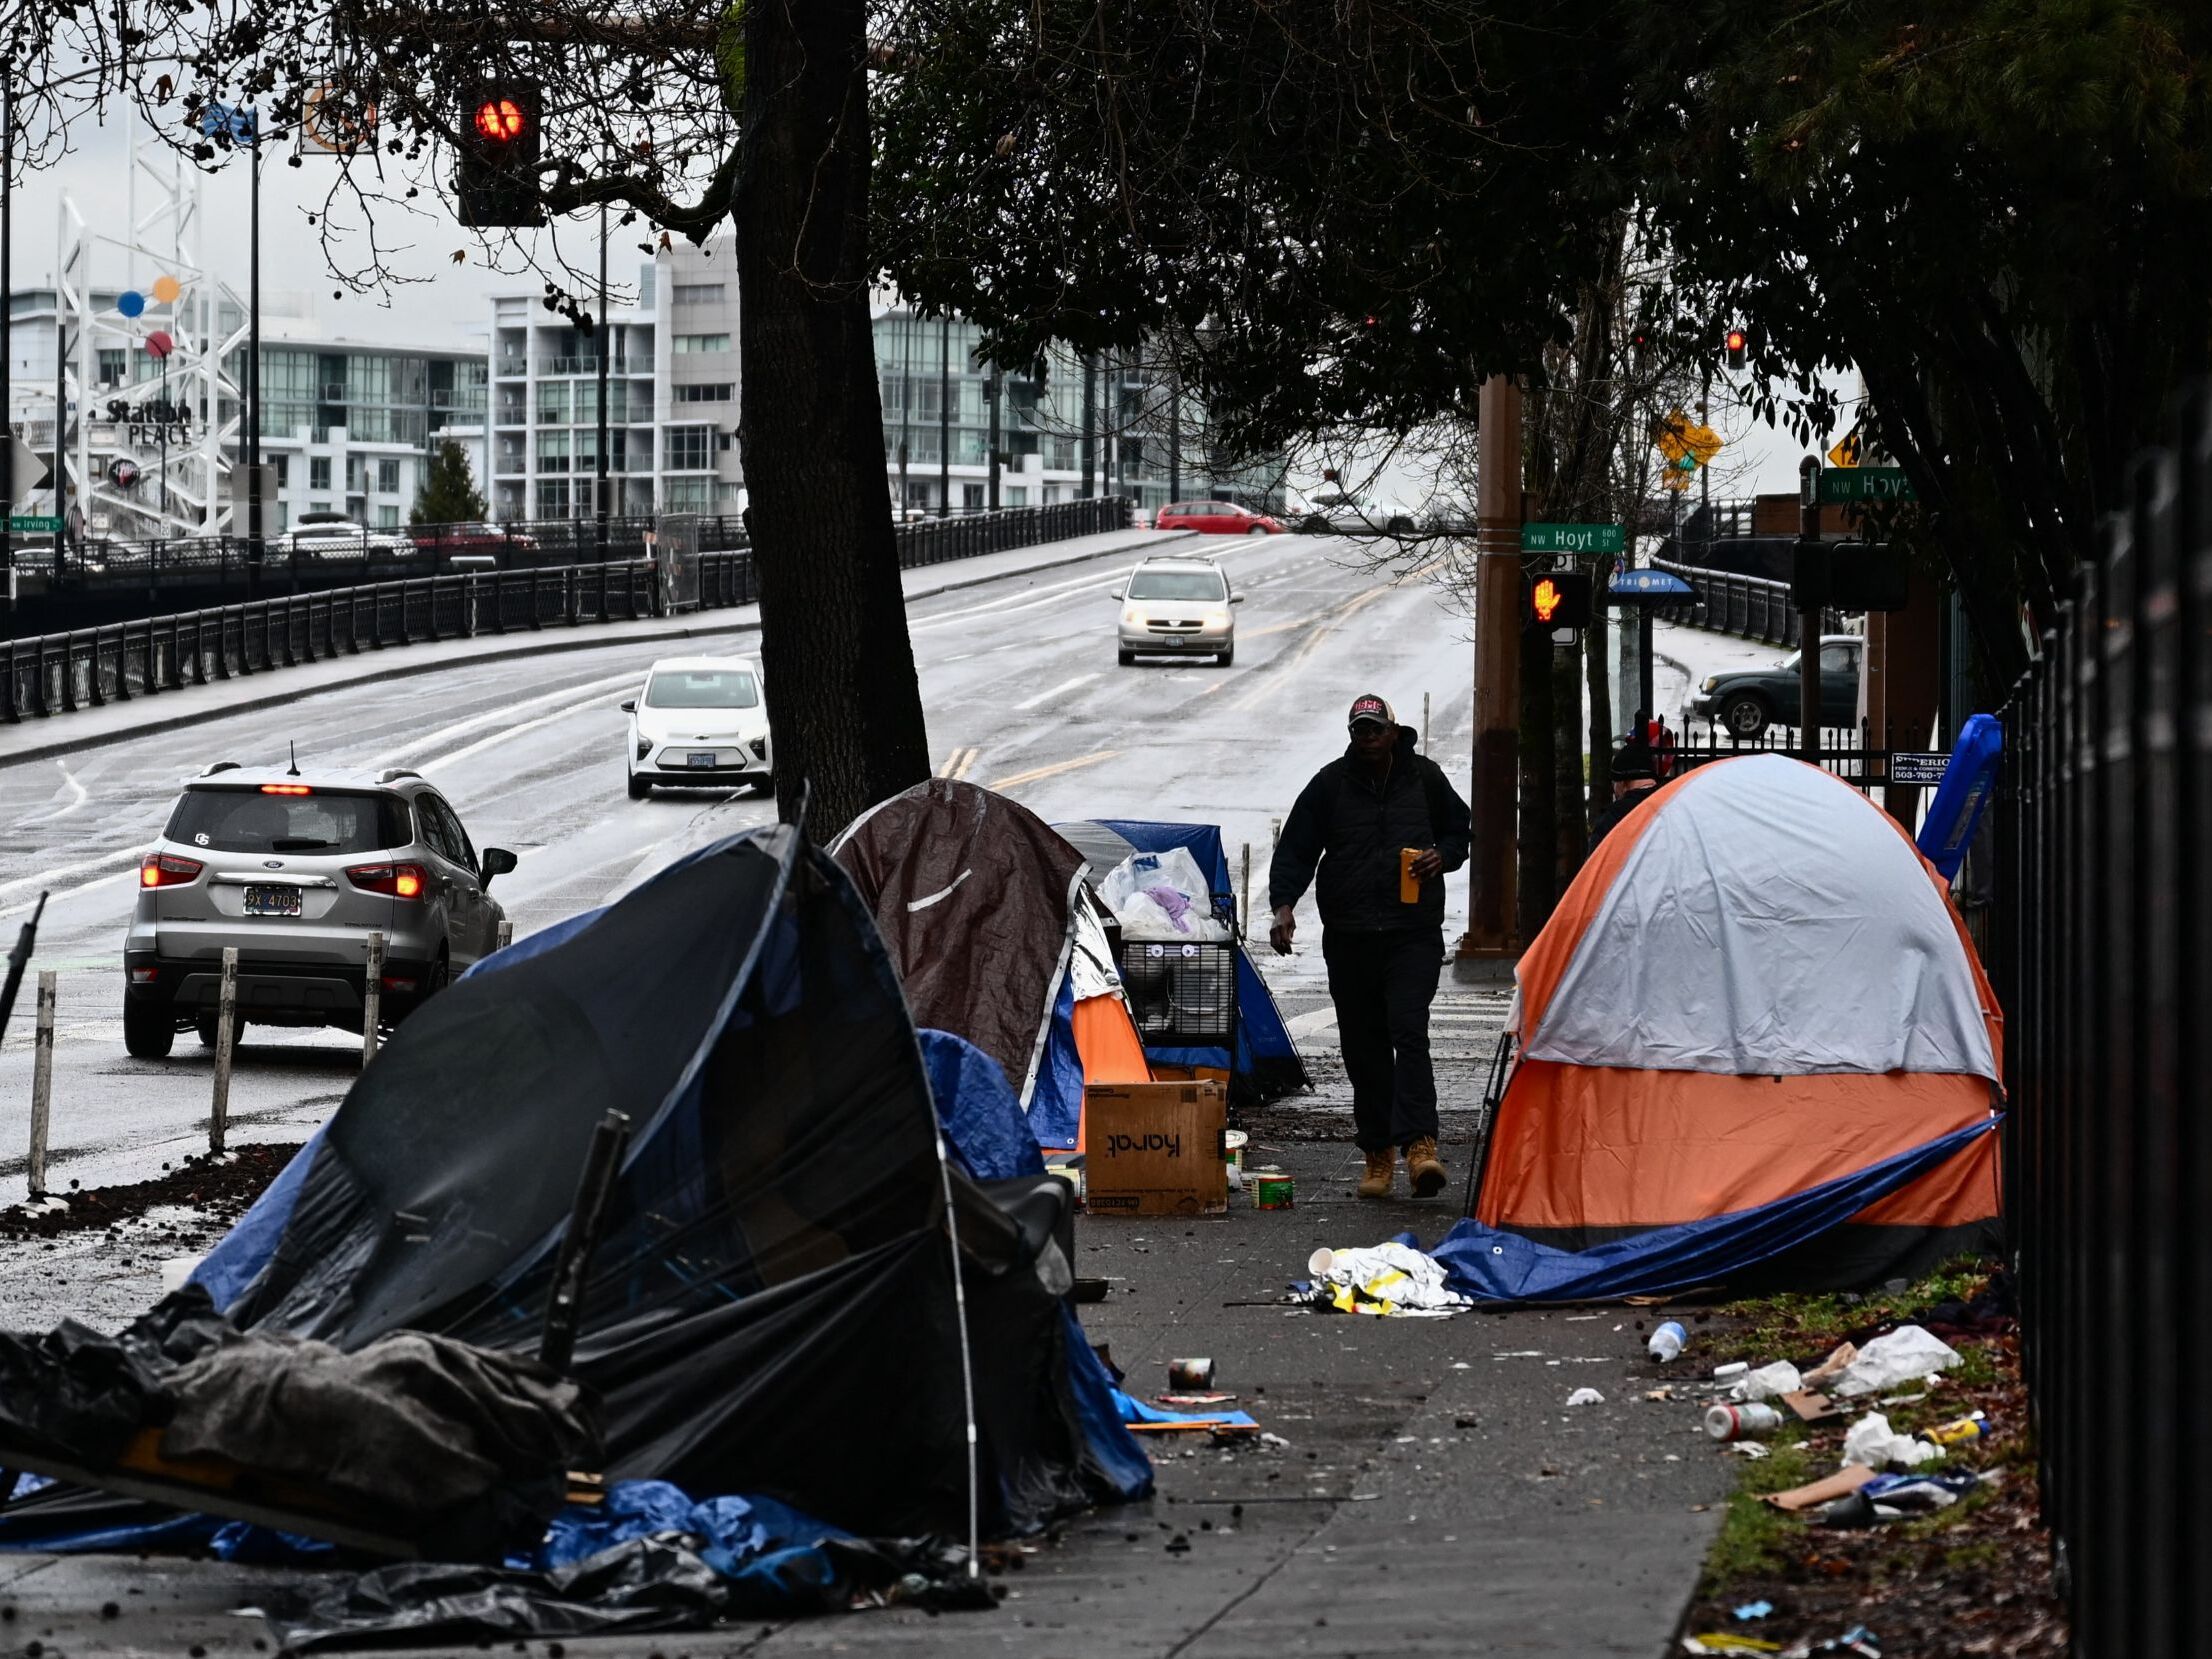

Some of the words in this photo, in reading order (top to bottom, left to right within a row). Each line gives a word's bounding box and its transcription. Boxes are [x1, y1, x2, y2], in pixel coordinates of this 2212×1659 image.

[129, 425, 192, 444] PLACE
[1832, 481, 1851, 494] NW
[1530, 535, 1546, 545] NW
[1555, 530, 1593, 550] Hoyt
[1602, 529, 1617, 538] 600
[1651, 578, 1673, 586] MET
[1895, 755, 1951, 767] SERIO
[1107, 1133, 1181, 1158] karat
